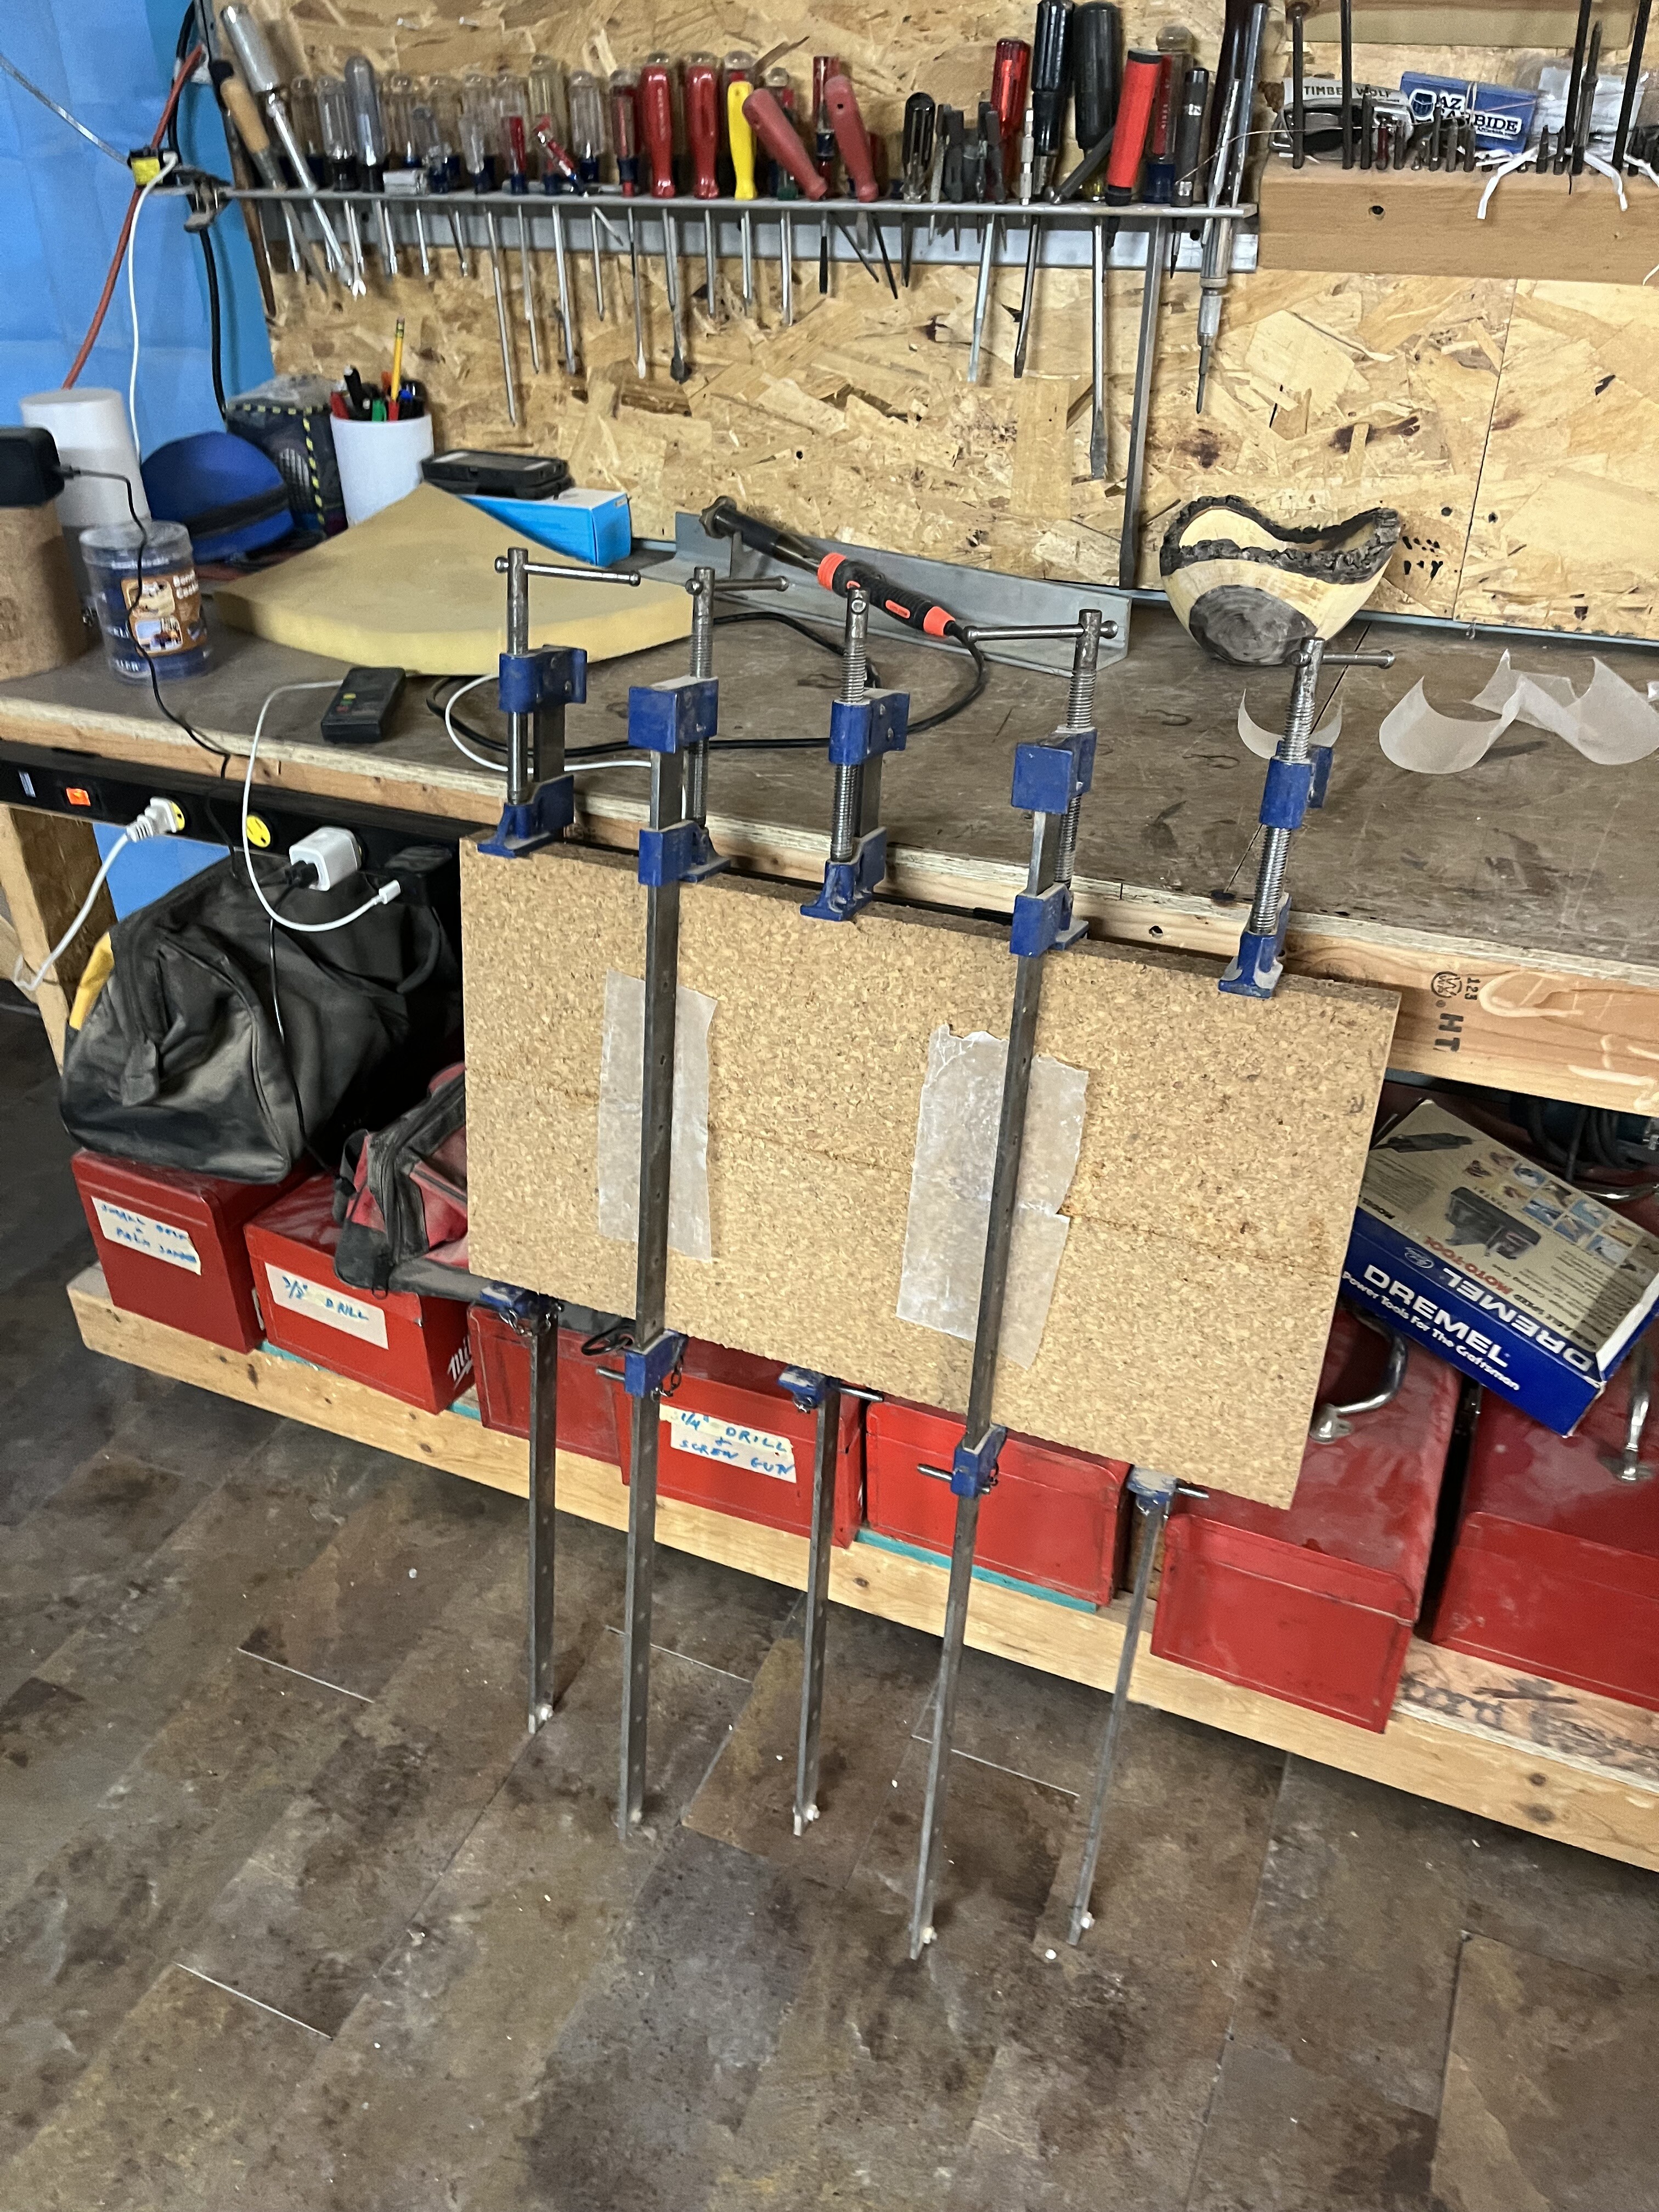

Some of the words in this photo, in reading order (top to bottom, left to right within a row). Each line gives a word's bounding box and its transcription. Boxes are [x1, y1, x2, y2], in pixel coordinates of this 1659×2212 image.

[1304, 86, 1343, 96] TIMBE
[1434, 1013, 1464, 1052] HT
[326, 1297, 369, 1321] DRILL
[1364, 1264, 1508, 1368] DREMEL
[1443, 1268, 1594, 1372] DREMEL
[1342, 1271, 1379, 1299] Power
[1381, 1295, 1409, 1319] Tools
[1410, 1316, 1431, 1331] For
[1432, 1328, 1454, 1347] The
[1456, 1345, 1521, 1391] Craftsman
[680, 1440, 739, 1460] SCREW
[751, 1457, 795, 1476] GUN
[725, 1426, 787, 1453] DRILL
